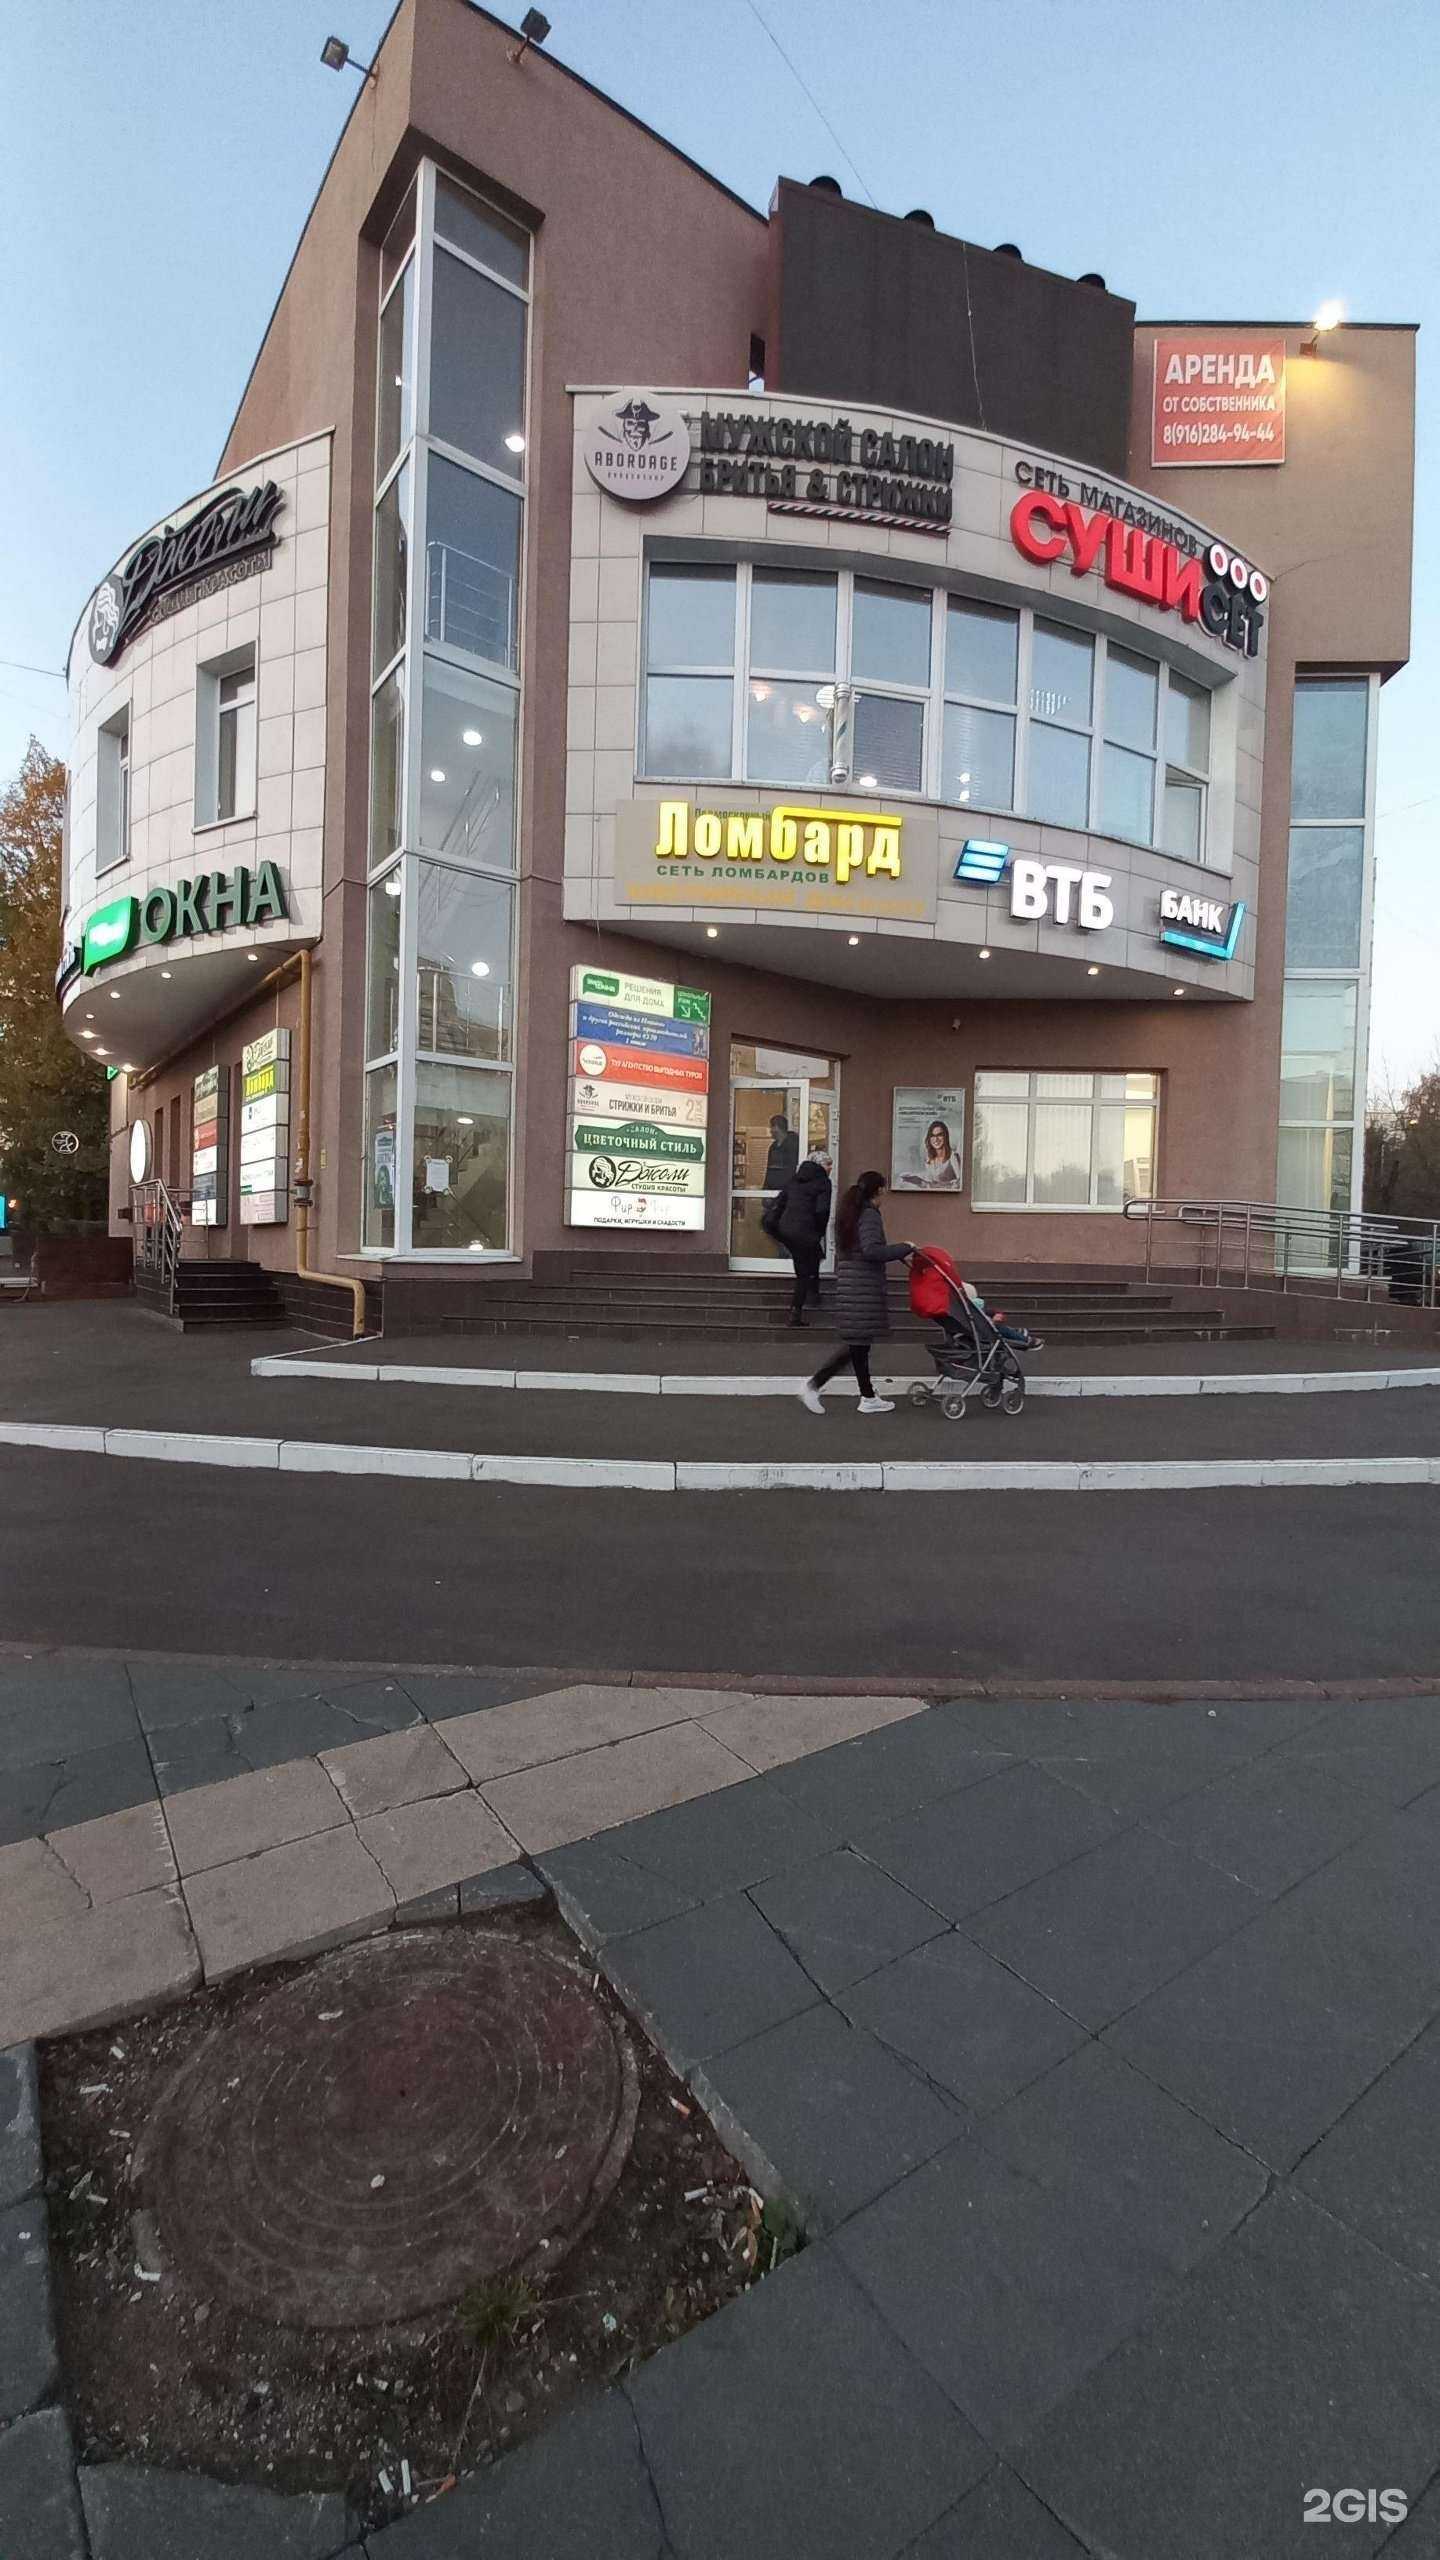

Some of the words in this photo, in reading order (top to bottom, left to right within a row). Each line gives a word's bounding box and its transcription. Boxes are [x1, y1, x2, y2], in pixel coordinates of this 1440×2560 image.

[1164, 354, 1276, 389] АРЕНДА
[1163, 396, 1179, 412] ОТ
[1181, 395, 1276, 412] СОБСТВЕННИКА
[701, 411, 852, 464] МУЖСКОЙ
[860, 428, 954, 482] САЛОН
[1163, 422, 1275, 446] 8(916)284-94-44
[594, 451, 677, 471] ABORDAGE
[700, 458, 797, 498] БРИТЬЯ
[806, 469, 828, 501] &
[837, 470, 953, 522] СТРИЖКИ
[1014, 460, 1070, 498] СЕТЬ
[1080, 482, 1198, 556] МАГАЗИНОВ
[656, 801, 902, 884] Ломбард
[656, 864, 704, 877] СЕТЬ
[711, 866, 830, 884] ЛОМБАРДОВ
[140, 860, 289, 945] ОКНА
[1008, 859, 1114, 932] ВТБ
[1160, 889, 1225, 934] БАНК
[609, 1100, 643, 1113] СТРИЖКИ
[644, 1103, 650, 1113] И
[651, 1103, 677, 1117] БРИТЬЯ
[583, 1133, 657, 1151] ЦВЕТОЧНЫЙ
[660, 1141, 697, 1154] СТИЛЬ
[614, 1160, 690, 1187] Джоли
[657, 1185, 686, 1193] КРАСОТЫ
